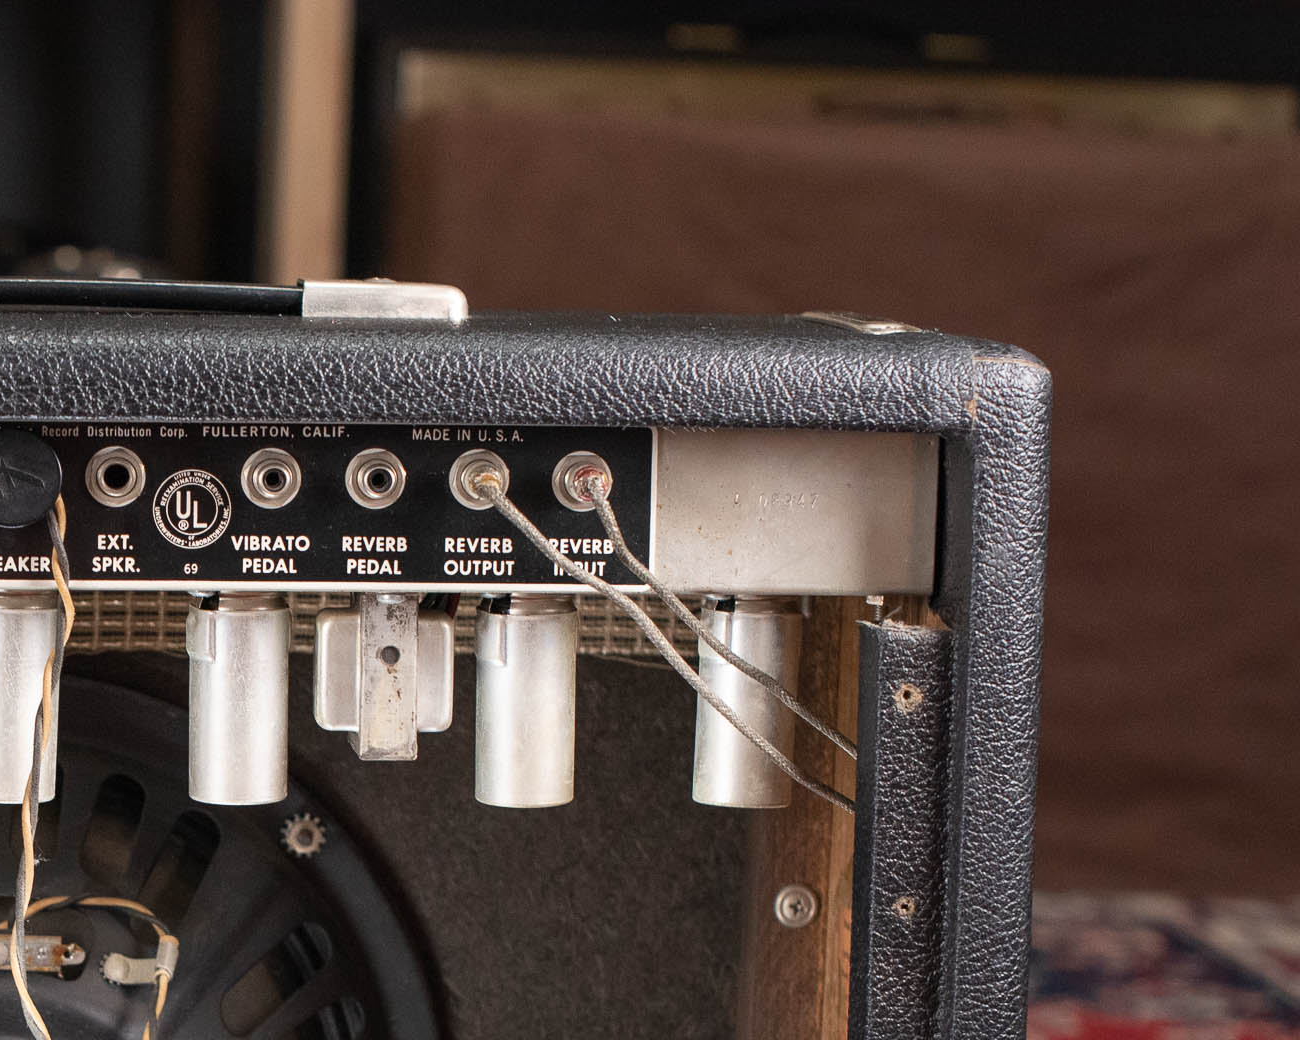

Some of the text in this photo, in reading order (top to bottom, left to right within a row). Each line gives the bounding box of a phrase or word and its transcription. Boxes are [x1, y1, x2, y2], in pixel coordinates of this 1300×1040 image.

[42, 425, 79, 437] Record
[87, 426, 152, 438] Distribution
[159, 426, 188, 439] Corp.
[303, 426, 350, 439] CALIF.
[412, 428, 451, 441] MADE
[457, 429, 471, 441] IN
[205, 481, 225, 506] SERVICE
[97, 534, 134, 550] EXT.
[231, 536, 310, 552] VIBRATO
[342, 536, 408, 552] REVERB
[444, 538, 513, 554] REVERB
[92, 557, 141, 573] SPKR.
[183, 562, 199, 575] 69
[242, 559, 298, 574] PEDAL
[346, 559, 402, 575] PEDAL
[444, 560, 514, 576] OUTPUT
